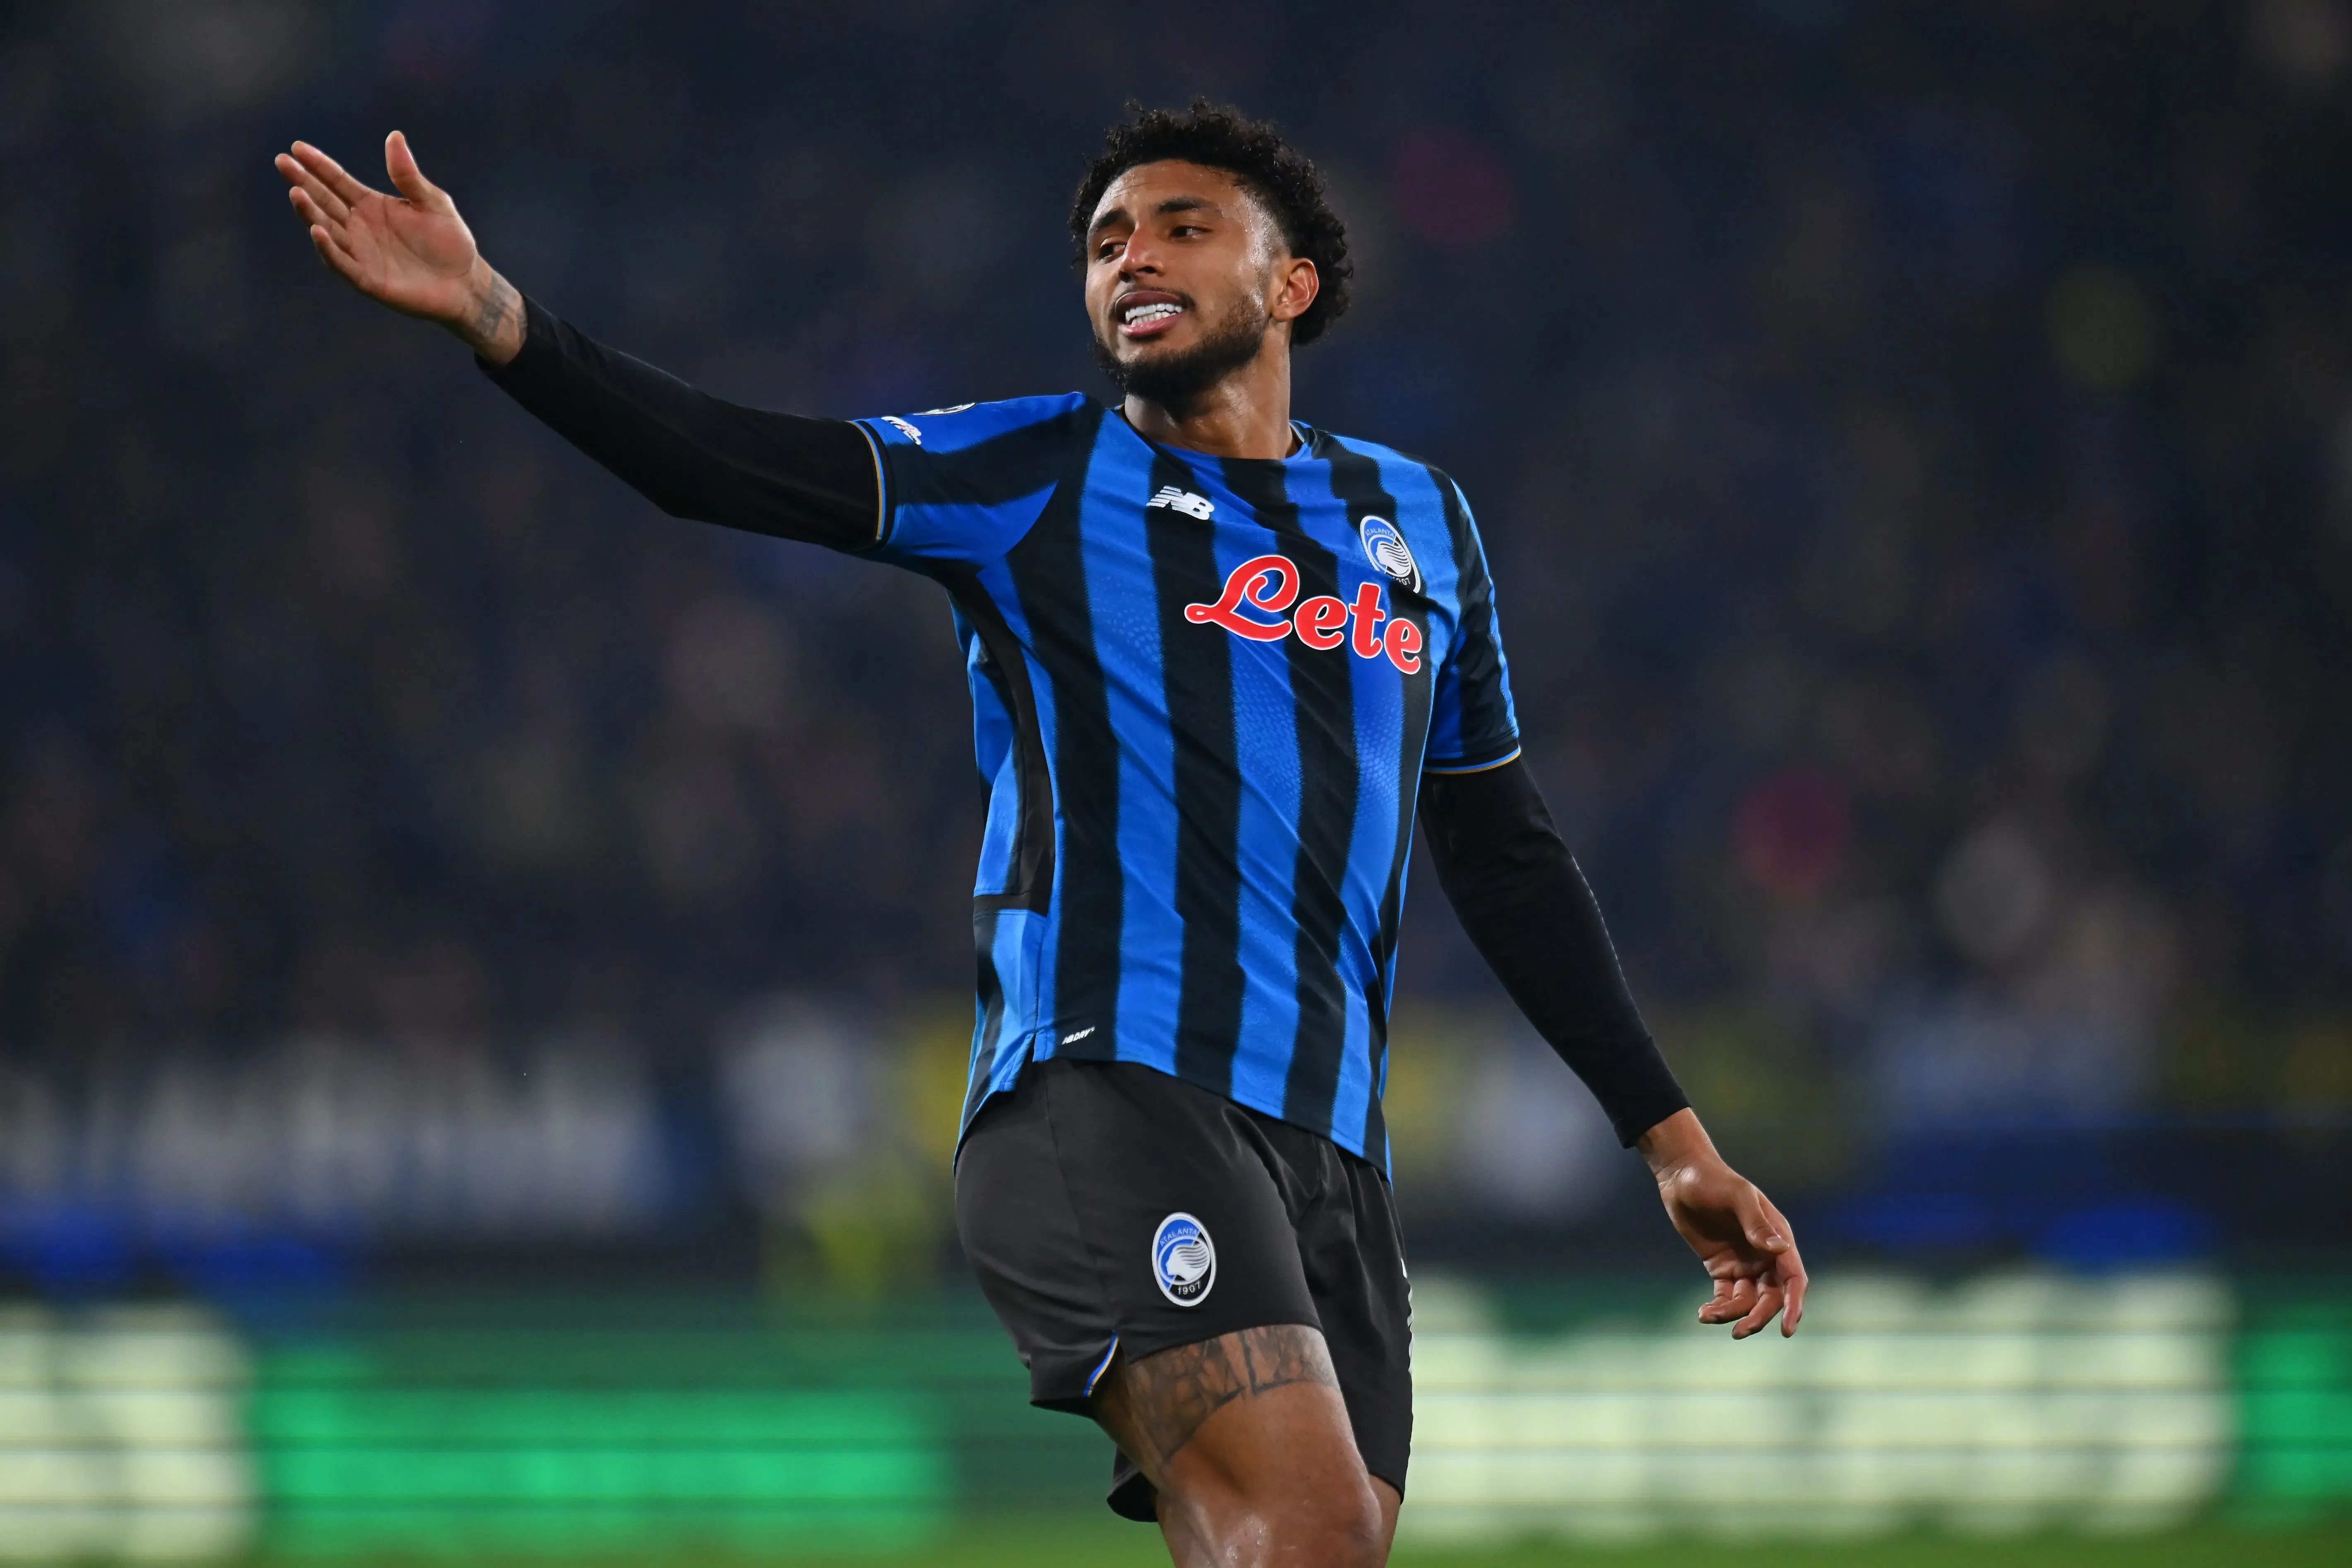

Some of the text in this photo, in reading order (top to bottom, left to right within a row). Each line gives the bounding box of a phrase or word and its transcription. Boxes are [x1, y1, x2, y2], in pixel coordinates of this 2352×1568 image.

[1365, 528, 1395, 538] ATALANTA
[1184, 554, 1422, 674] Lete
[1160, 1228, 1197, 1247] ATALANTA
[1177, 1281, 1201, 1295] 1907
